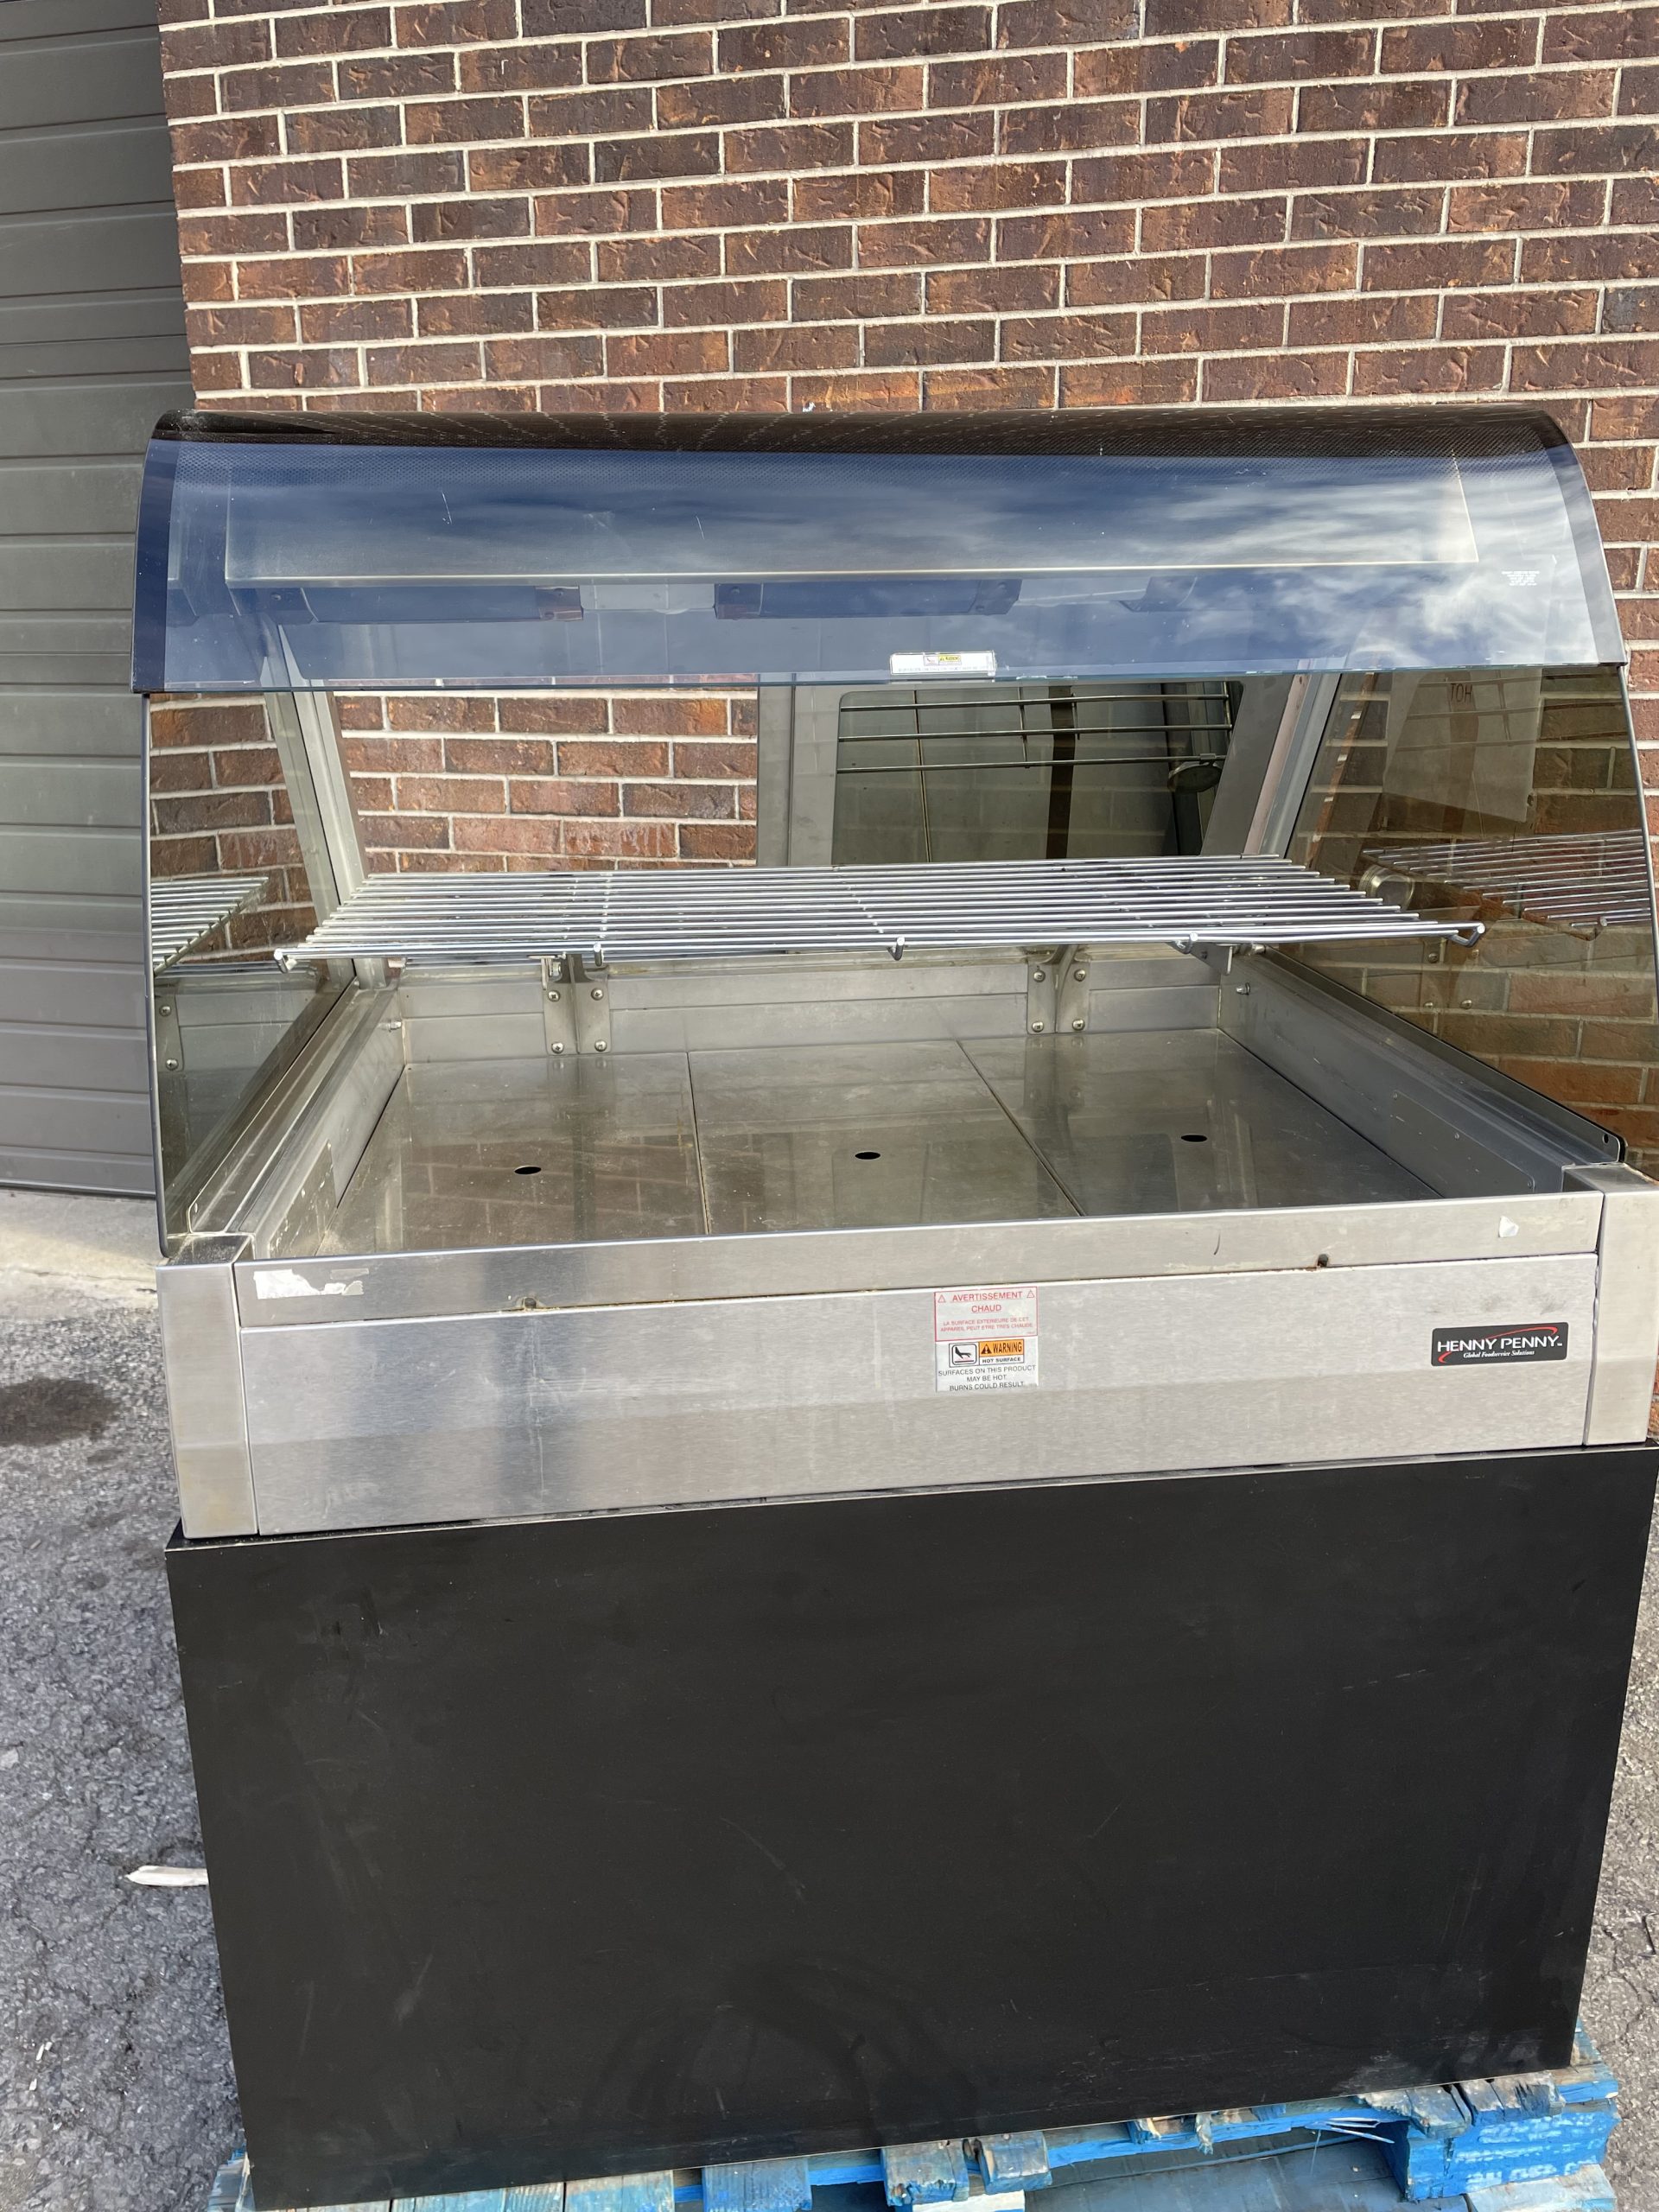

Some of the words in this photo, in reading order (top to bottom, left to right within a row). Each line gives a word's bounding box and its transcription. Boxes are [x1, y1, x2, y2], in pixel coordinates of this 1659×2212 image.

[952, 1291, 1022, 1301] AVERTISSEMENT
[971, 1304, 1001, 1313] CHAUD
[993, 1341, 1022, 1353] WARNING
[1437, 1339, 1497, 1352] HENNY
[1463, 1351, 1482, 1359] Global
